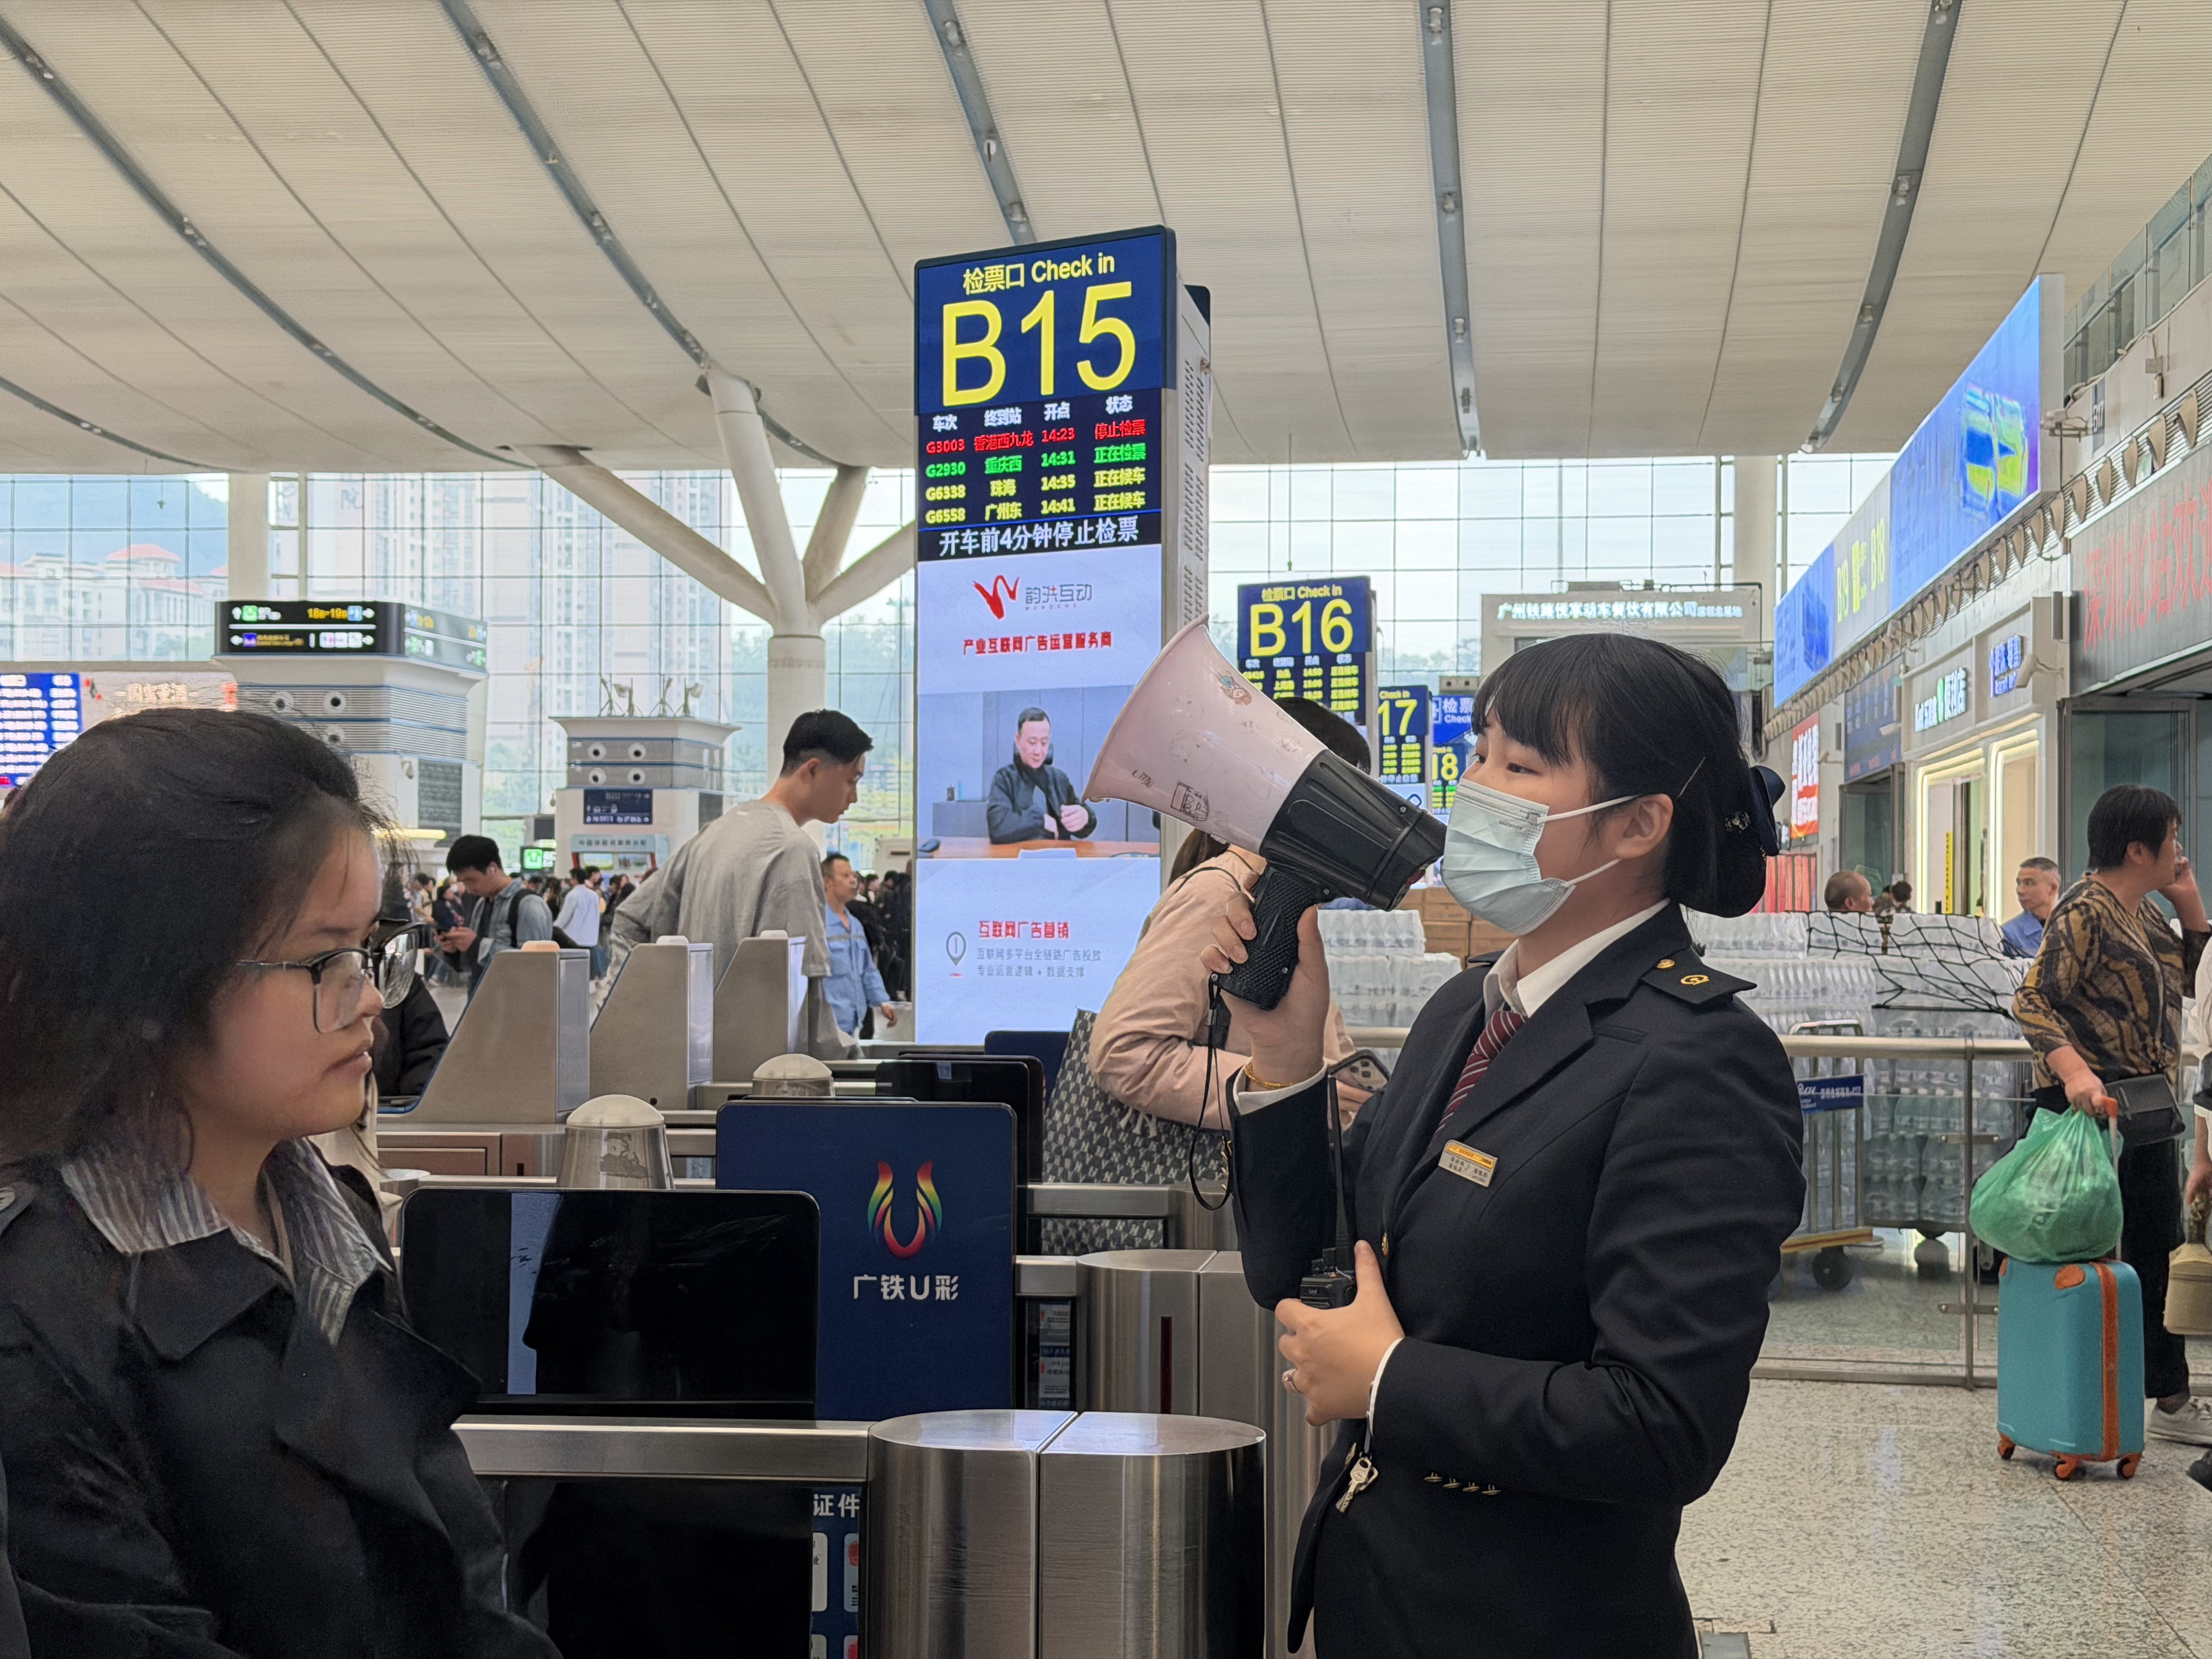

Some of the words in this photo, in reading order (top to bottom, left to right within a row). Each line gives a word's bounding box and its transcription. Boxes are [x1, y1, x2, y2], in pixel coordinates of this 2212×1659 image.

[963, 263, 1025, 295] 检票口
[1032, 255, 1093, 283] Check
[1098, 252, 1114, 273] in
[943, 281, 1136, 407] B15
[933, 414, 957, 432] 车次
[984, 408, 1022, 427] 终到站
[1044, 402, 1070, 421] 开点
[1106, 395, 1133, 414] 状态
[926, 439, 965, 454] G3003
[974, 430, 1034, 453] 香港西九龙
[1041, 427, 1075, 442] 14:23
[1094, 420, 1146, 440] 停止检票
[926, 462, 966, 477] G2930
[984, 455, 1022, 474] 重庆西
[1041, 450, 1075, 466] 14:31
[1094, 443, 1146, 464] 正在检票
[926, 486, 966, 500] G6338
[990, 479, 1016, 496] 珠海
[1041, 475, 1075, 490] 14:35
[1094, 467, 1145, 487] 正在候车
[926, 509, 966, 523] G6558
[985, 503, 1022, 521] 广州东
[1041, 498, 1075, 514] 14:41
[1094, 492, 1145, 511] 正在候车
[940, 516, 1138, 557] 开车前4分钟停止检票
[1297, 585, 1330, 599] Check
[1332, 585, 1342, 596] in
[963, 631, 1111, 656] 产业互联网广告运营服务商
[1251, 599, 1353, 657] B16
[1377, 699, 1418, 736] 17
[979, 921, 1069, 939] 互联网广告营销
[854, 1274, 959, 1301] 广铁U彩
[813, 1493, 860, 1517] 证件
